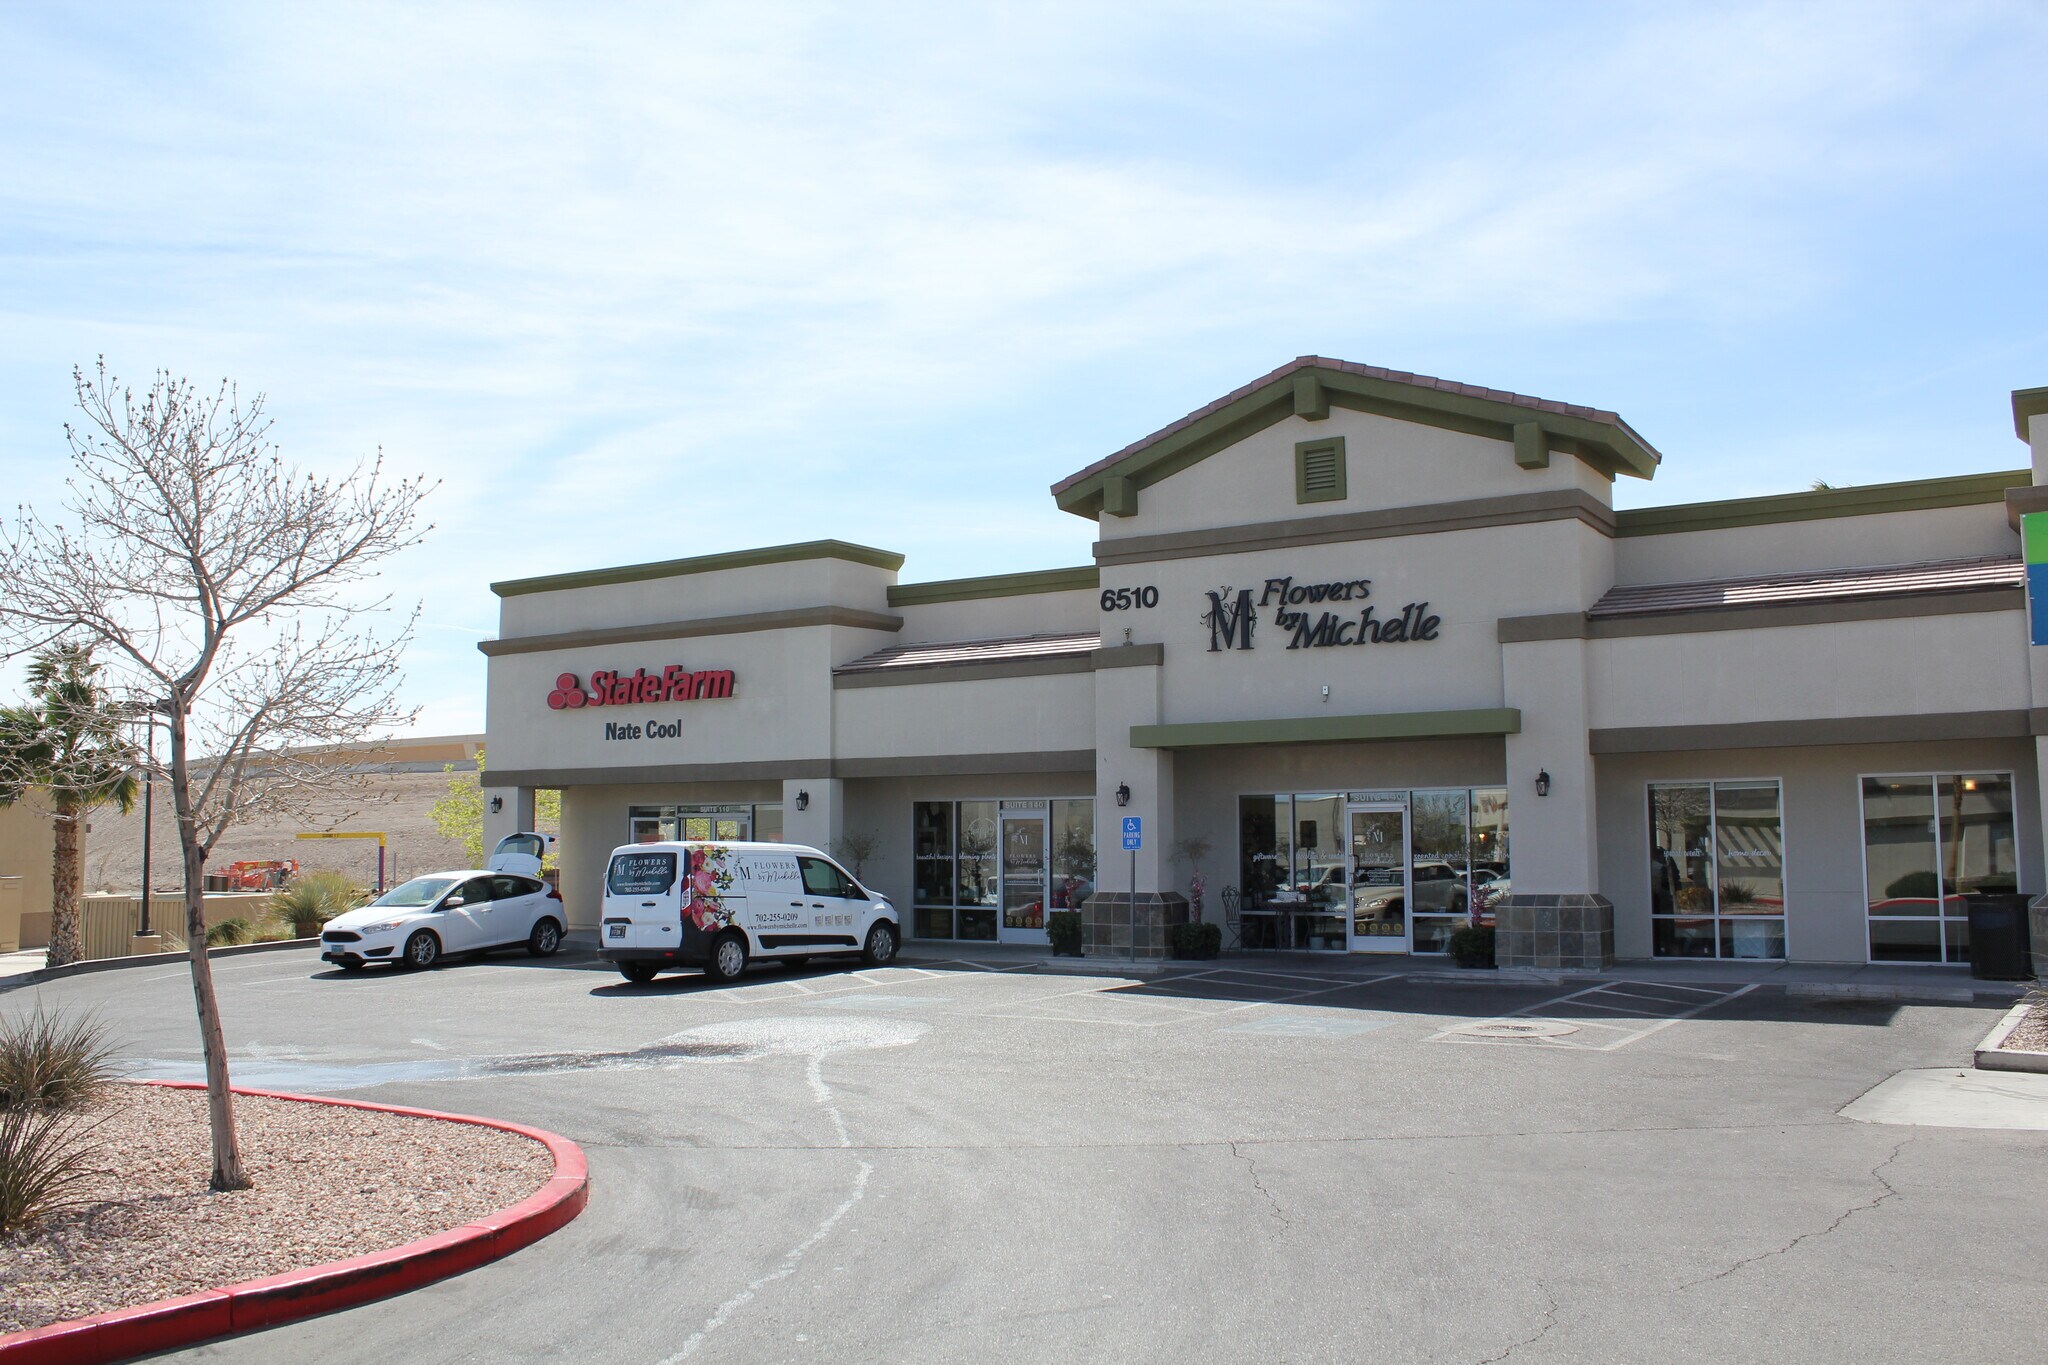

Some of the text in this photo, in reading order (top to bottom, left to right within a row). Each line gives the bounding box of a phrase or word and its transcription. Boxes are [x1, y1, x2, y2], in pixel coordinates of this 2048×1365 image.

[1258, 576, 1371, 607] Flowers
[1100, 586, 1158, 612] 6510
[1201, 586, 1257, 652] M
[1275, 602, 1441, 650] by Michelle
[605, 719, 682, 740] Nate Cool
[959, 852, 980, 862] blooming
[1414, 851, 1439, 859] scented
[1728, 848, 1772, 858] home decor
[628, 859, 667, 867] FLOWERS
[617, 864, 626, 876] M
[740, 866, 752, 880] M
[755, 913, 799, 922] 702-255-0209
[747, 922, 808, 930] www.flowersbymichelle.com
